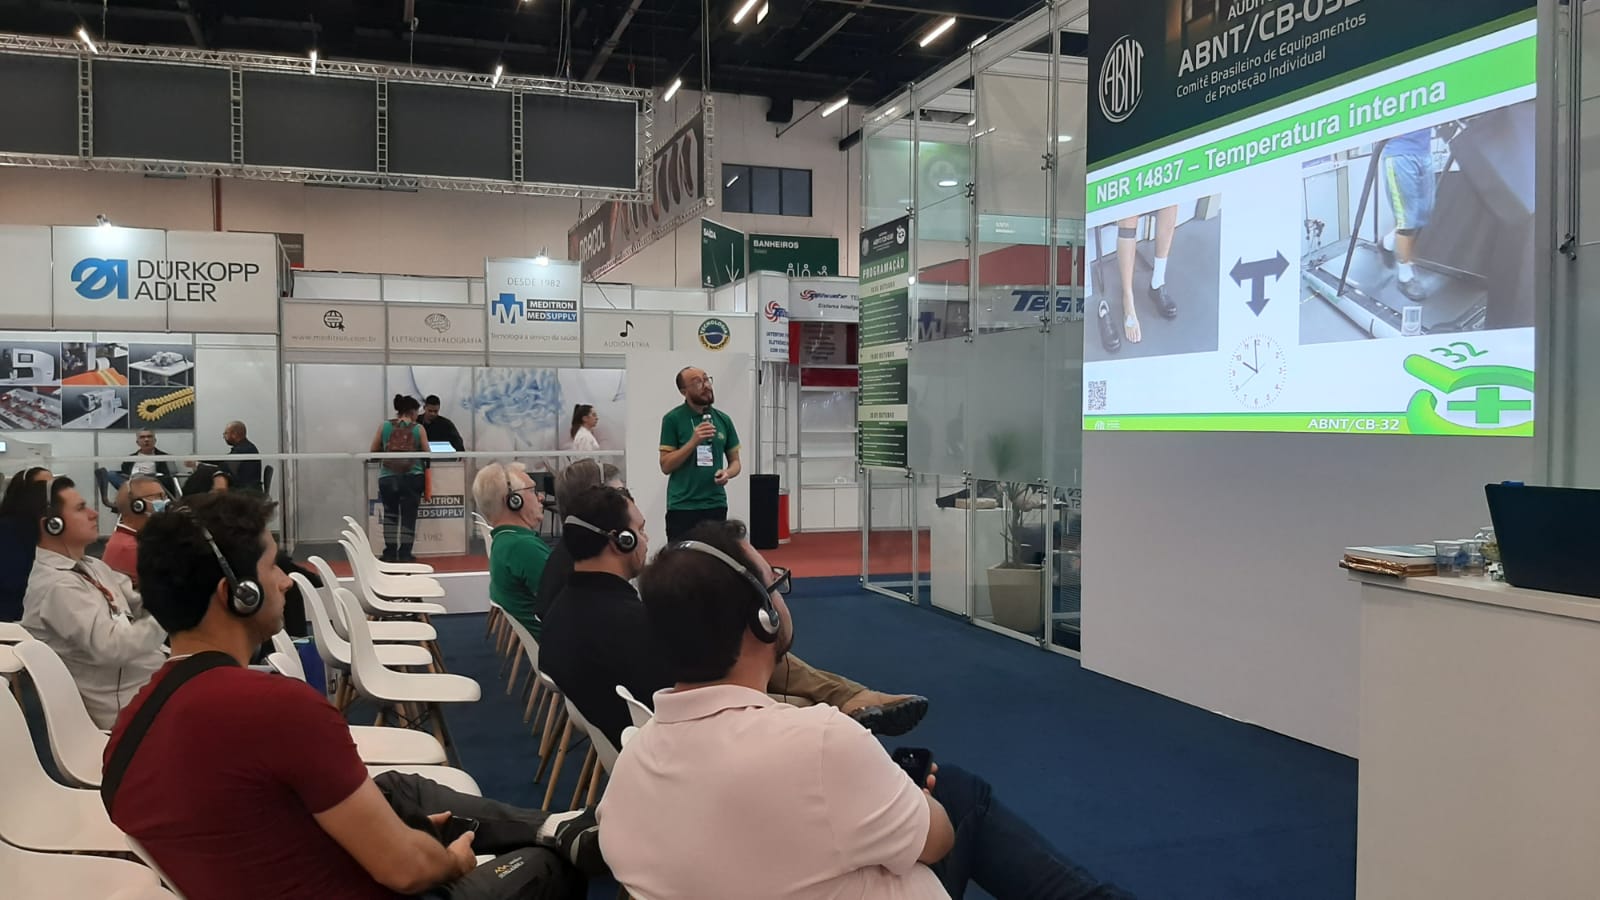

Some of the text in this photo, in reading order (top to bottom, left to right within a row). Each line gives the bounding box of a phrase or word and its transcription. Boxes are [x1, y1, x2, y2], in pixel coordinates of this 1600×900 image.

[1176, 13, 1366, 98] Comitê Brasileiro de Equipamentos
[1205, 46, 1326, 104] de Proteção Individual
[1096, 176, 1130, 205] NBR
[1135, 158, 1184, 193] 14837
[1204, 111, 1340, 173] Temperatura
[1349, 80, 1447, 128] interna
[754, 240, 799, 249] BANHEIROS
[138, 260, 260, 282] DÜRKOPP
[862, 256, 905, 280] PROGRAMAÇÃO
[134, 281, 217, 302] ADLER
[507, 277, 561, 288] DESDE 1982
[530, 300, 574, 310] MEDITRON
[527, 311, 577, 321] MEDSUPPLY
[1308, 418, 1400, 433] ABNT/CB-32
